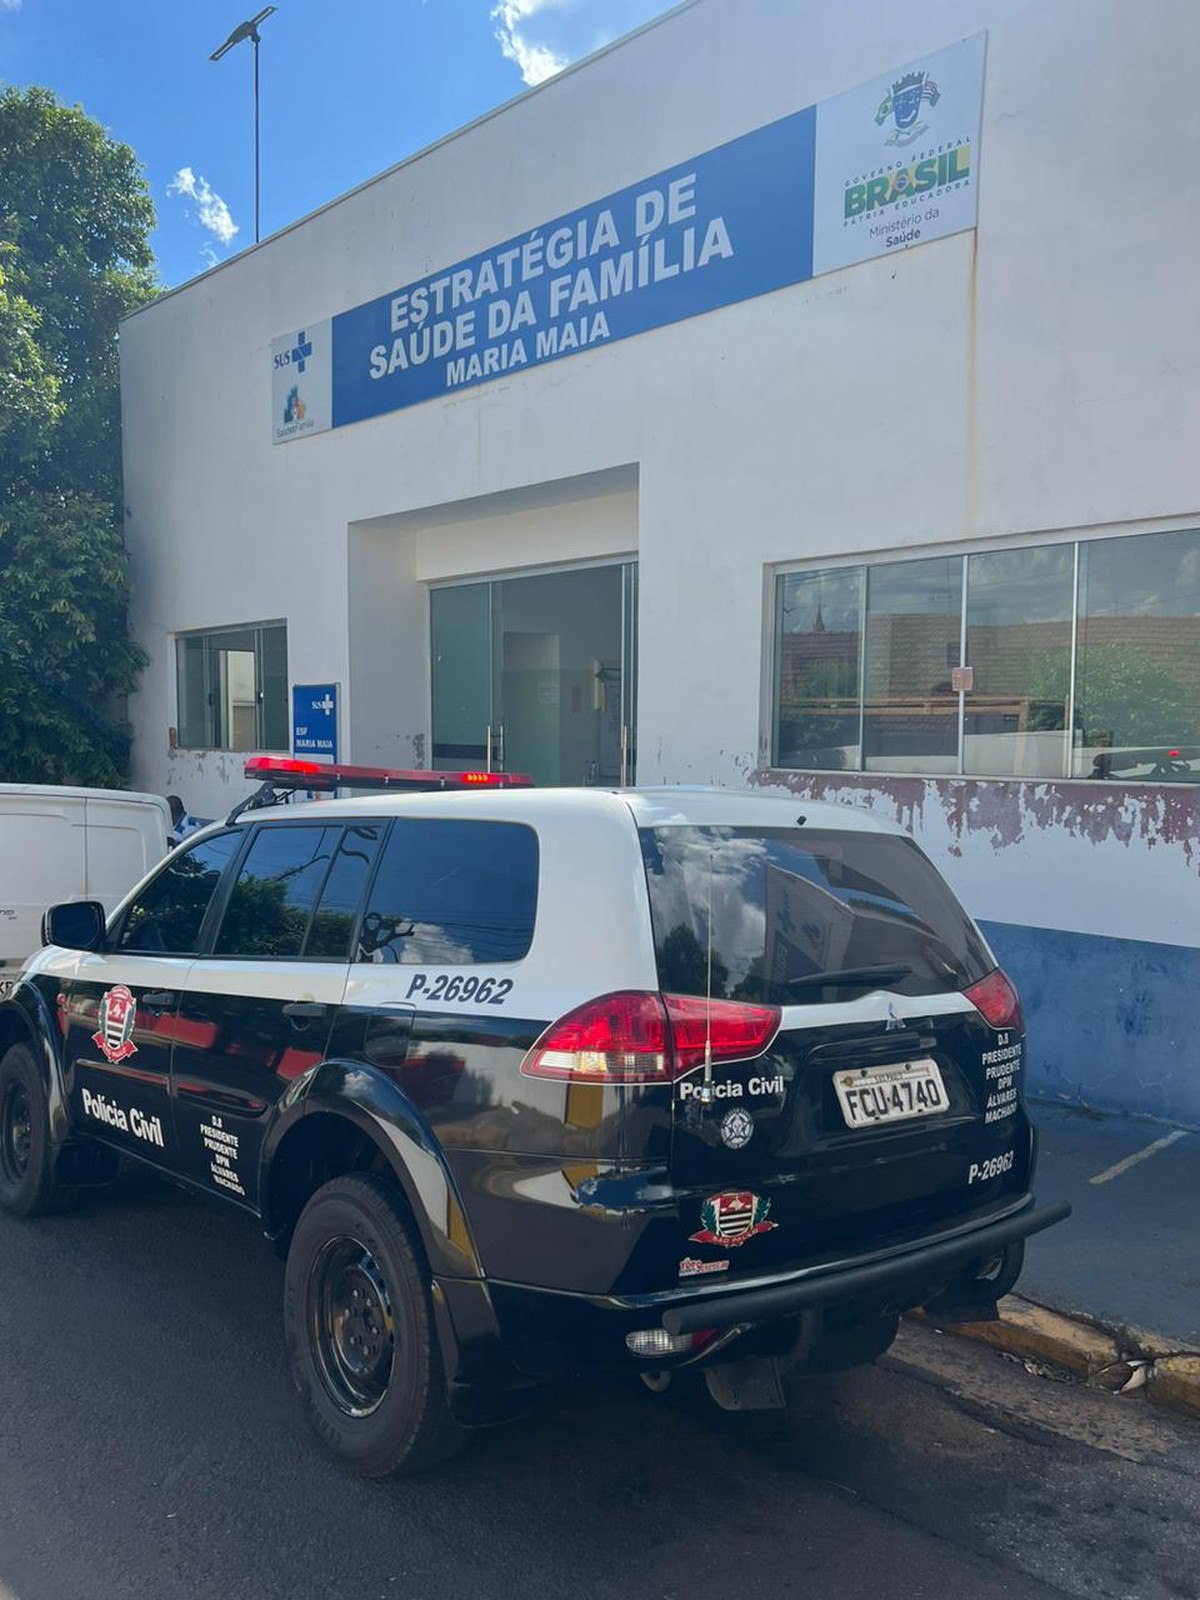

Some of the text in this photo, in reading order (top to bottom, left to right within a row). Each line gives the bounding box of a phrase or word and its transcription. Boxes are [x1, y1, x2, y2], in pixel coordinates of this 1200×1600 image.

[844, 136, 971, 187] GOVERNO FEDERAL
[844, 147, 970, 219] BRASIL
[894, 180, 970, 210] EDUCADORA
[869, 208, 940, 239] Ministério da
[885, 228, 921, 248] Saúde
[391, 172, 697, 333] ESTRATÉGIA DE
[369, 216, 734, 380] SAÚDE DA FAMÍLIA
[274, 350, 291, 369] SUS
[446, 311, 611, 387] MARIA MAIA
[296, 739, 334, 749] MARIA MAIA
[405, 974, 514, 1005] P-26962
[982, 1043, 1022, 1066] PRESIDENTE
[985, 1059, 1020, 1081] PRUDENTE
[748, 1076, 784, 1095] Civil
[81, 1088, 165, 1148] Polícia Civil
[200, 1123, 239, 1148] PRESIDENTE
[204, 1137, 238, 1159] PRUDENTE
[968, 1150, 1014, 1184] P-26962
